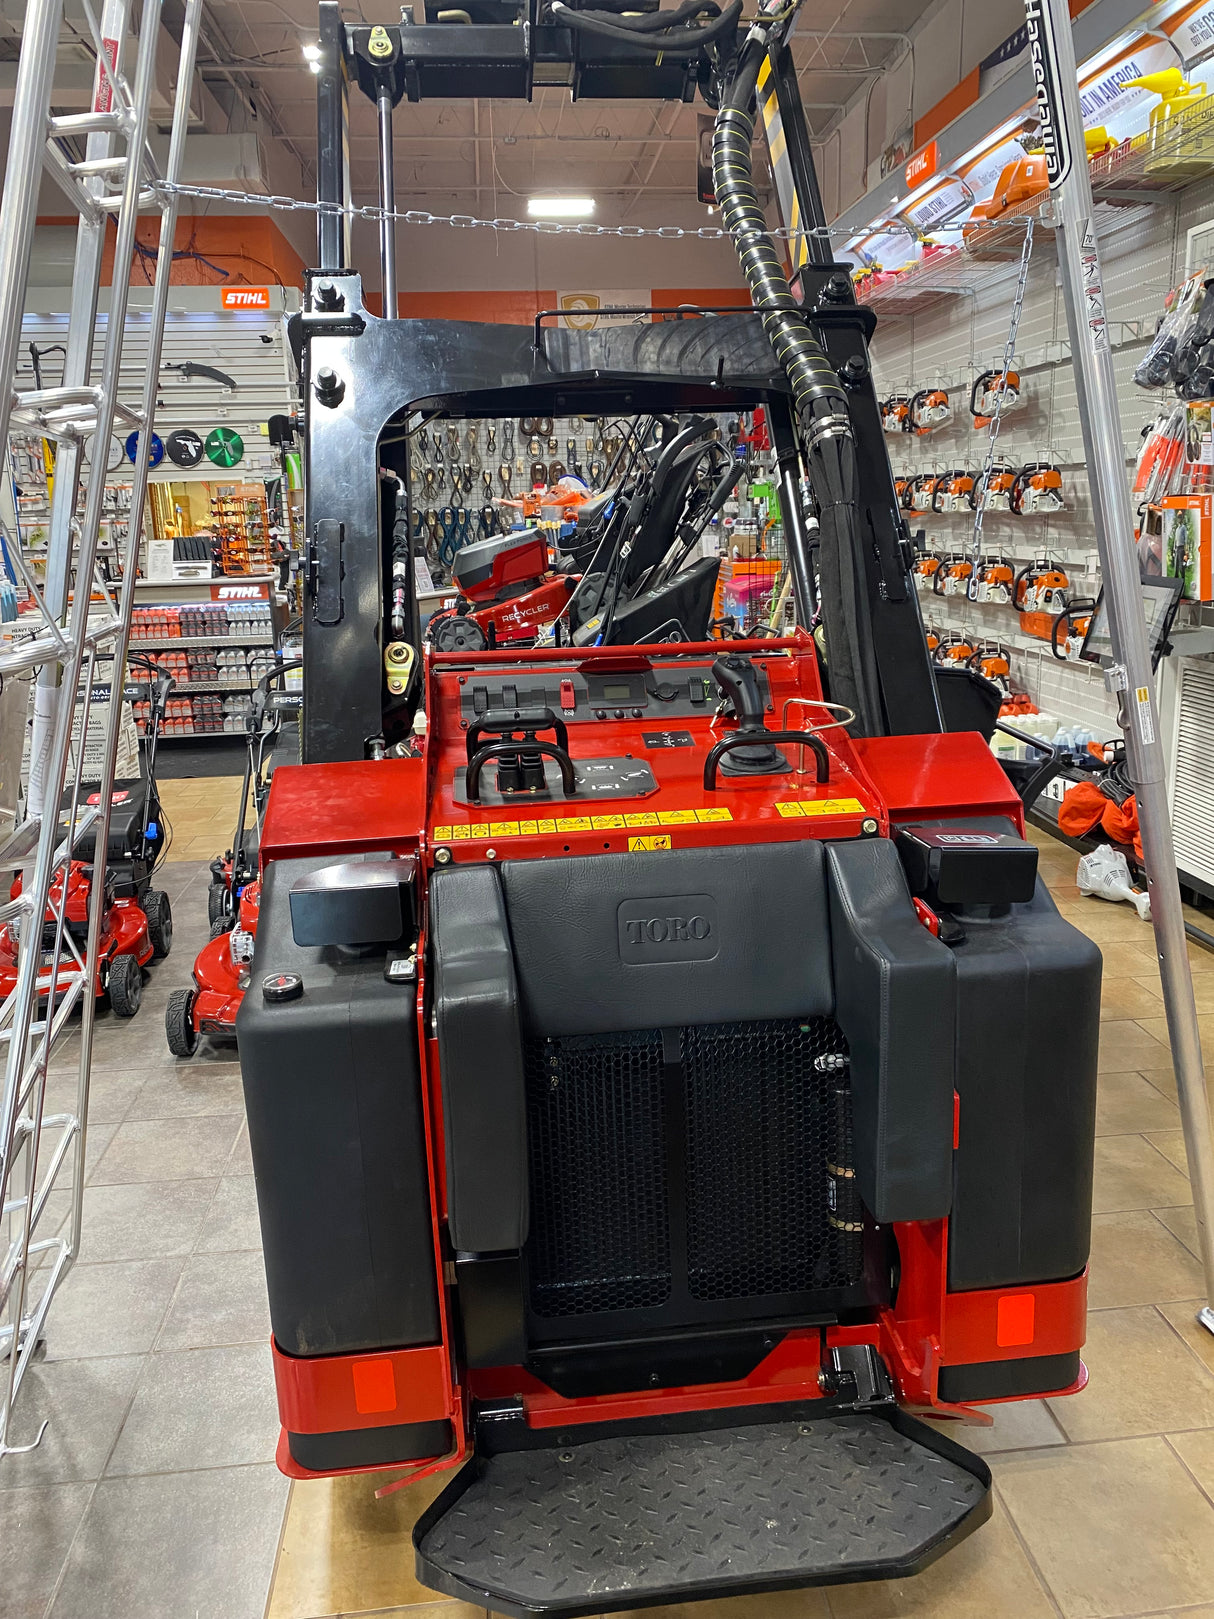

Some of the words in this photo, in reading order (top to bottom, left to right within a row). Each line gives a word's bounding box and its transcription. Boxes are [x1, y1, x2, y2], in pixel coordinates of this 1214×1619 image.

[1080, 95, 1095, 118] UILT
[1090, 88, 1106, 108] IN
[1098, 61, 1143, 102] AMERICA
[906, 152, 927, 180] STIHL
[225, 293, 267, 304] STIHL
[217, 586, 262, 599] STIHL
[502, 603, 549, 622] RECYCLER
[626, 916, 711, 944] TORO
